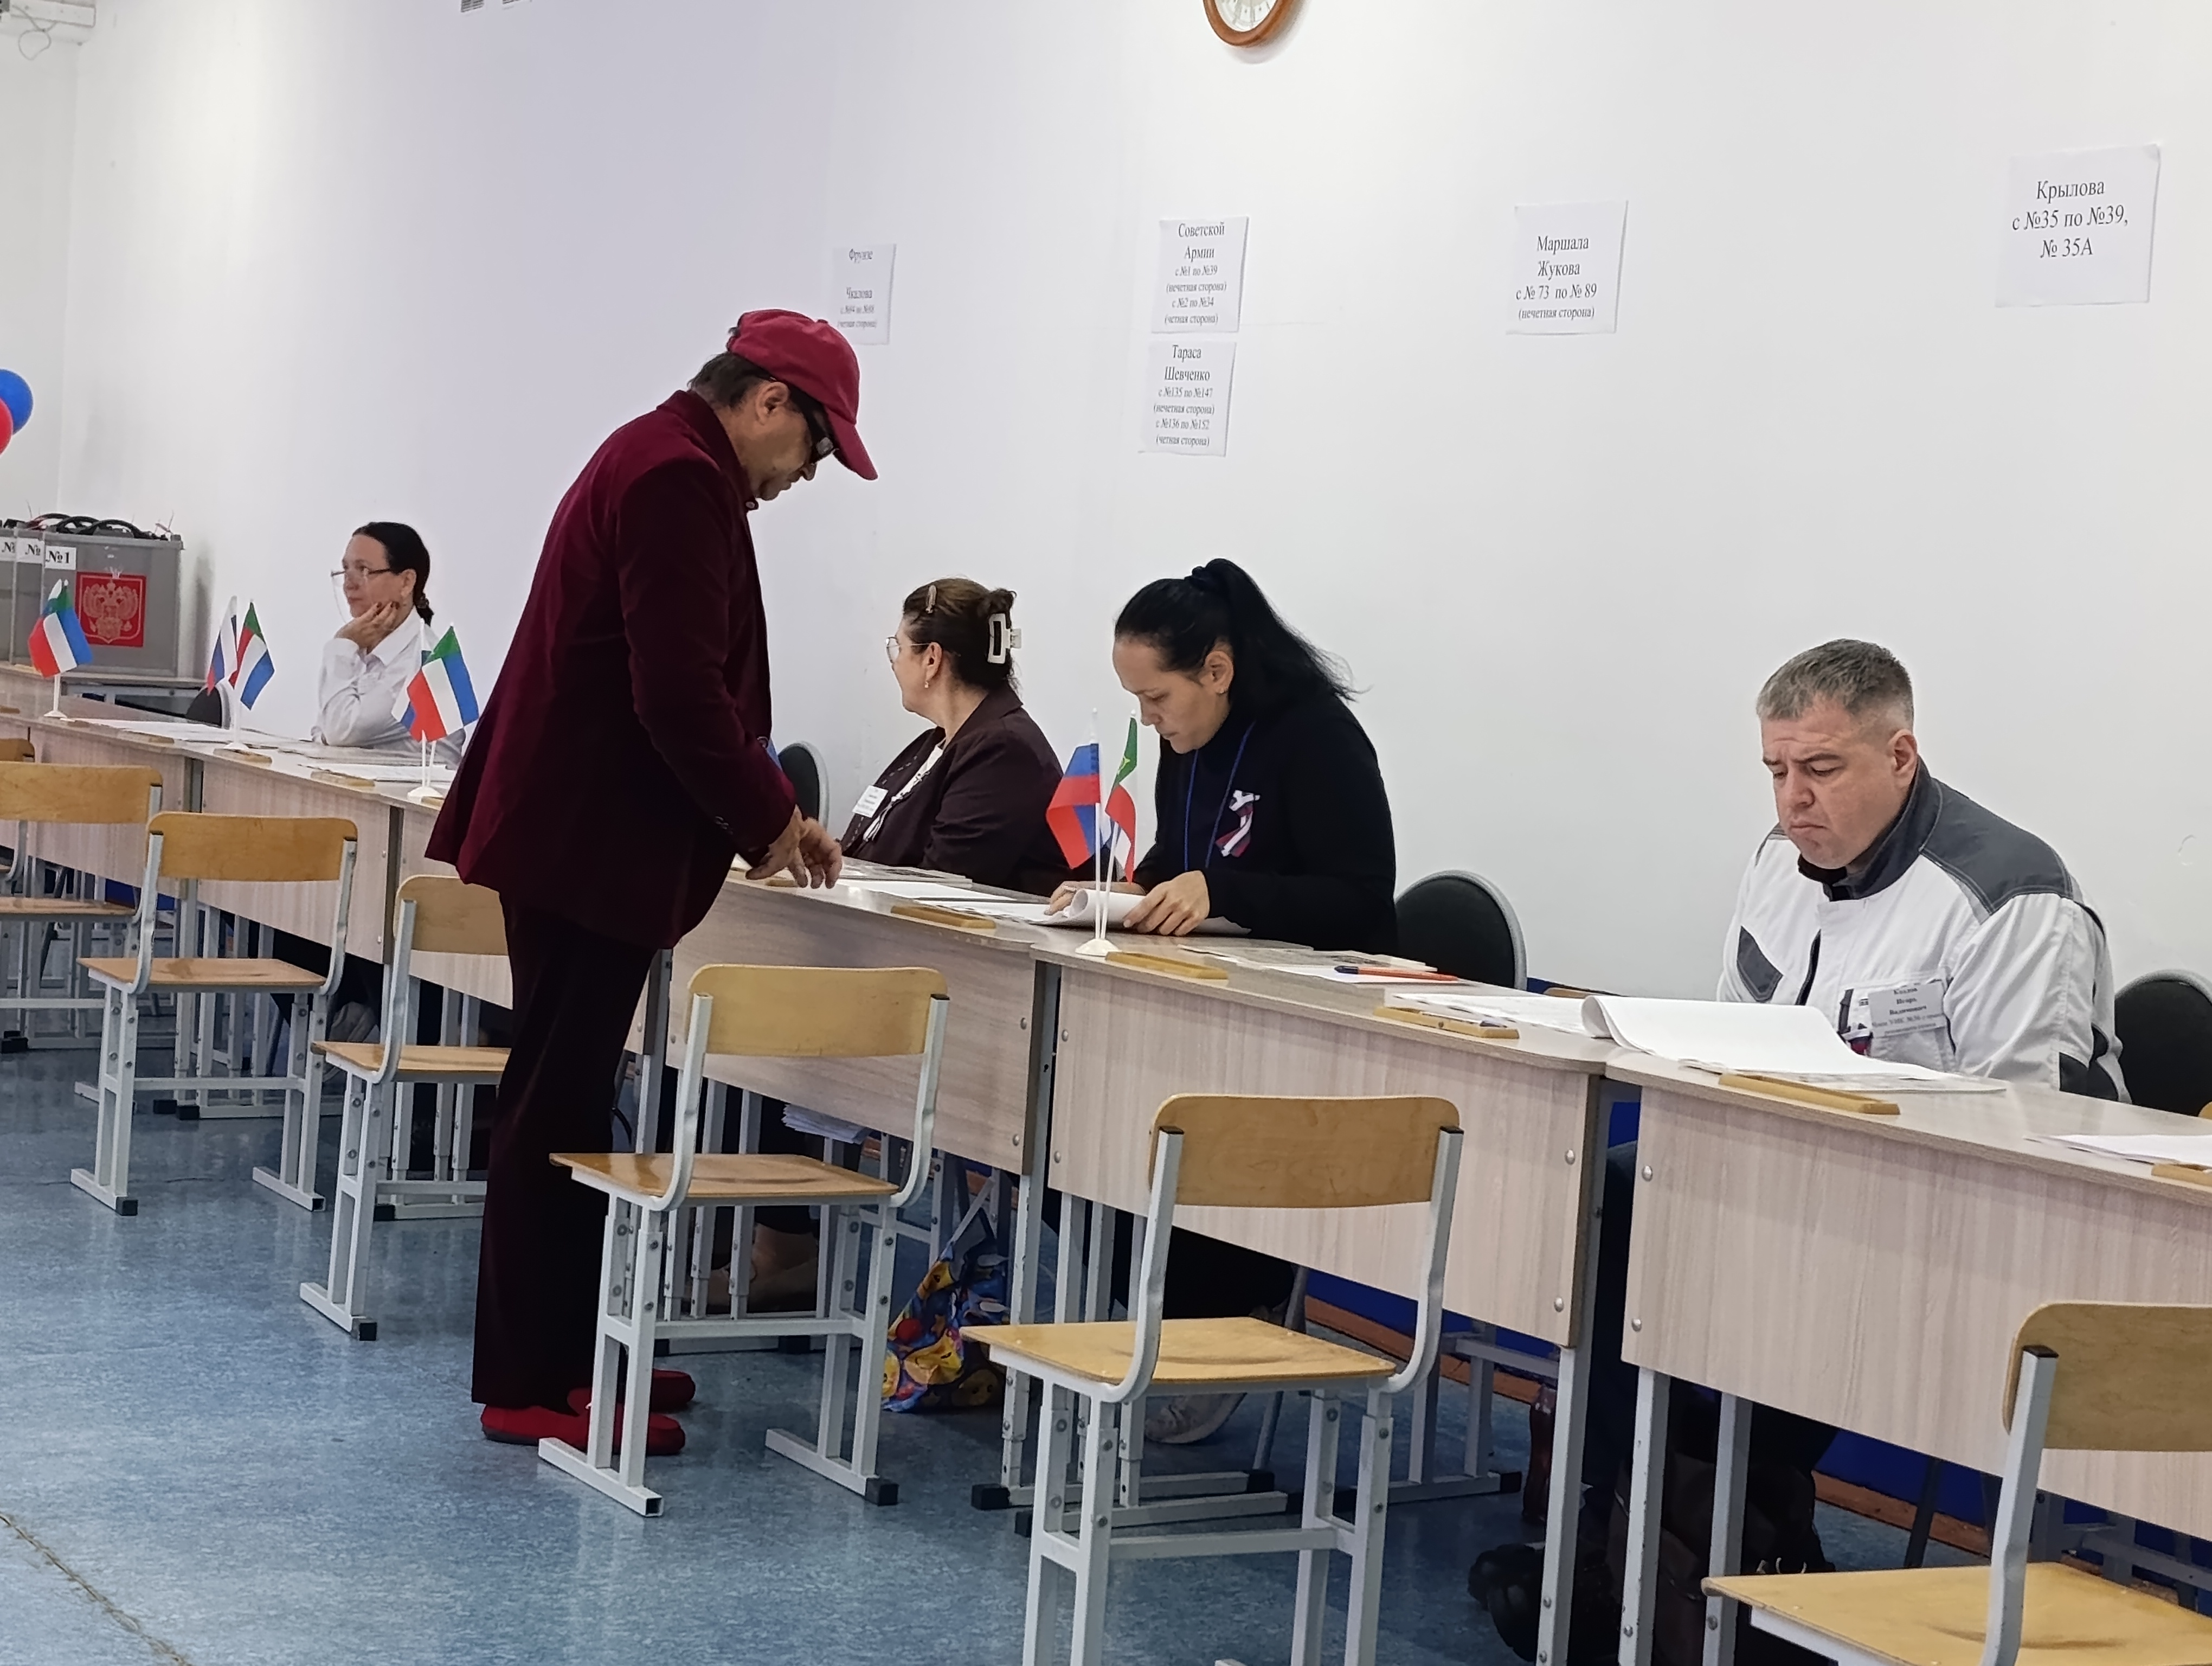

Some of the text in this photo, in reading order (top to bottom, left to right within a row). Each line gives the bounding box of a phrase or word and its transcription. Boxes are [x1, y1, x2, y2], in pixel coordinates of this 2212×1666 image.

[2036, 181, 2105, 204] Крылова
[2012, 204, 2128, 230] с №35 по №39,
[1178, 222, 1224, 237] Советской
[1537, 235, 1589, 255] Маршала
[2040, 238, 2093, 258] № 35А
[1185, 246, 1214, 262] Армии
[1180, 265, 1190, 276] №1
[1193, 268, 1200, 276] по
[1201, 265, 1218, 275] №39
[1538, 260, 1580, 280] Жукова
[1198, 281, 1226, 293] сторона)
[1516, 283, 1597, 300] с № 73 по № 89
[1519, 307, 1594, 321] (нечетная сторона)
[1172, 344, 1201, 362] Тараса
[1164, 366, 1210, 381] Шевченко
[1164, 386, 1182, 398] №135
[1186, 406, 1214, 416] сторона)
[1181, 437, 1210, 447] сторона)
[45, 550, 69, 563] №1
